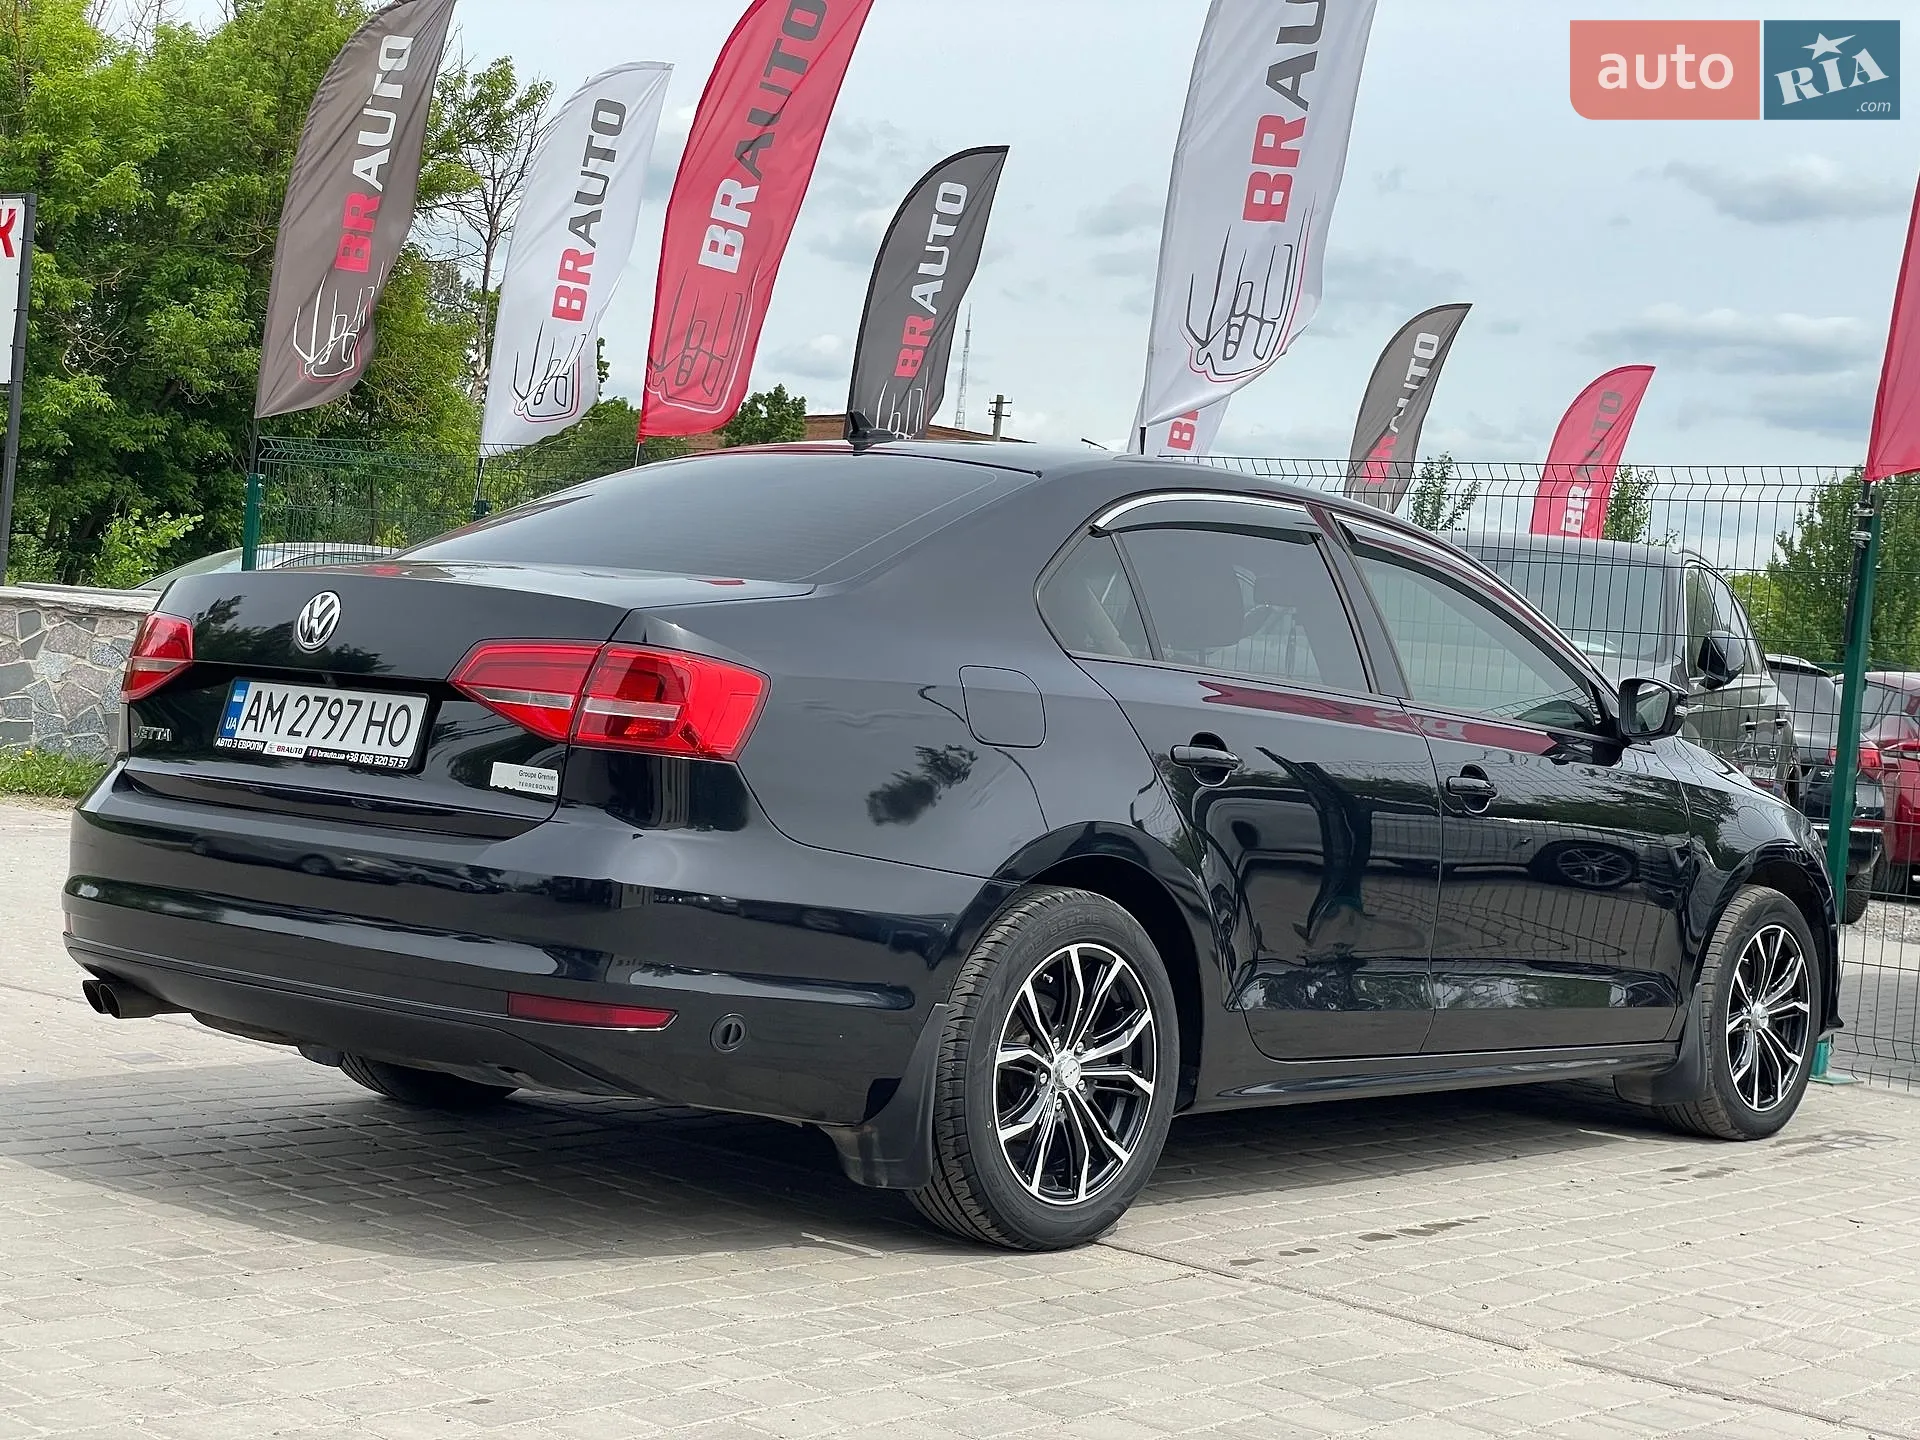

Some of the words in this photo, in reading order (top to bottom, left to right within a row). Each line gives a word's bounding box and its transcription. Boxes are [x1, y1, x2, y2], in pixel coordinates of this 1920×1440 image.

[334, 34, 414, 273] BRAUTO
[697, 0, 828, 274] BRAUTO
[551, 98, 627, 322] BRAUTO
[893, 181, 968, 378] BRAUTO
[134, 726, 172, 742] JETTA
[225, 717, 237, 730] UA
[241, 690, 289, 735] AM
[287, 695, 364, 742] 2797
[361, 701, 412, 748] HO
[276, 745, 304, 755] BRAUTO
[374, 755, 387, 766] 320
[388, 757, 399, 767] 57
[398, 758, 409, 768] 57
[519, 770, 536, 779] Groupe
[538, 772, 556, 781] Grenier
